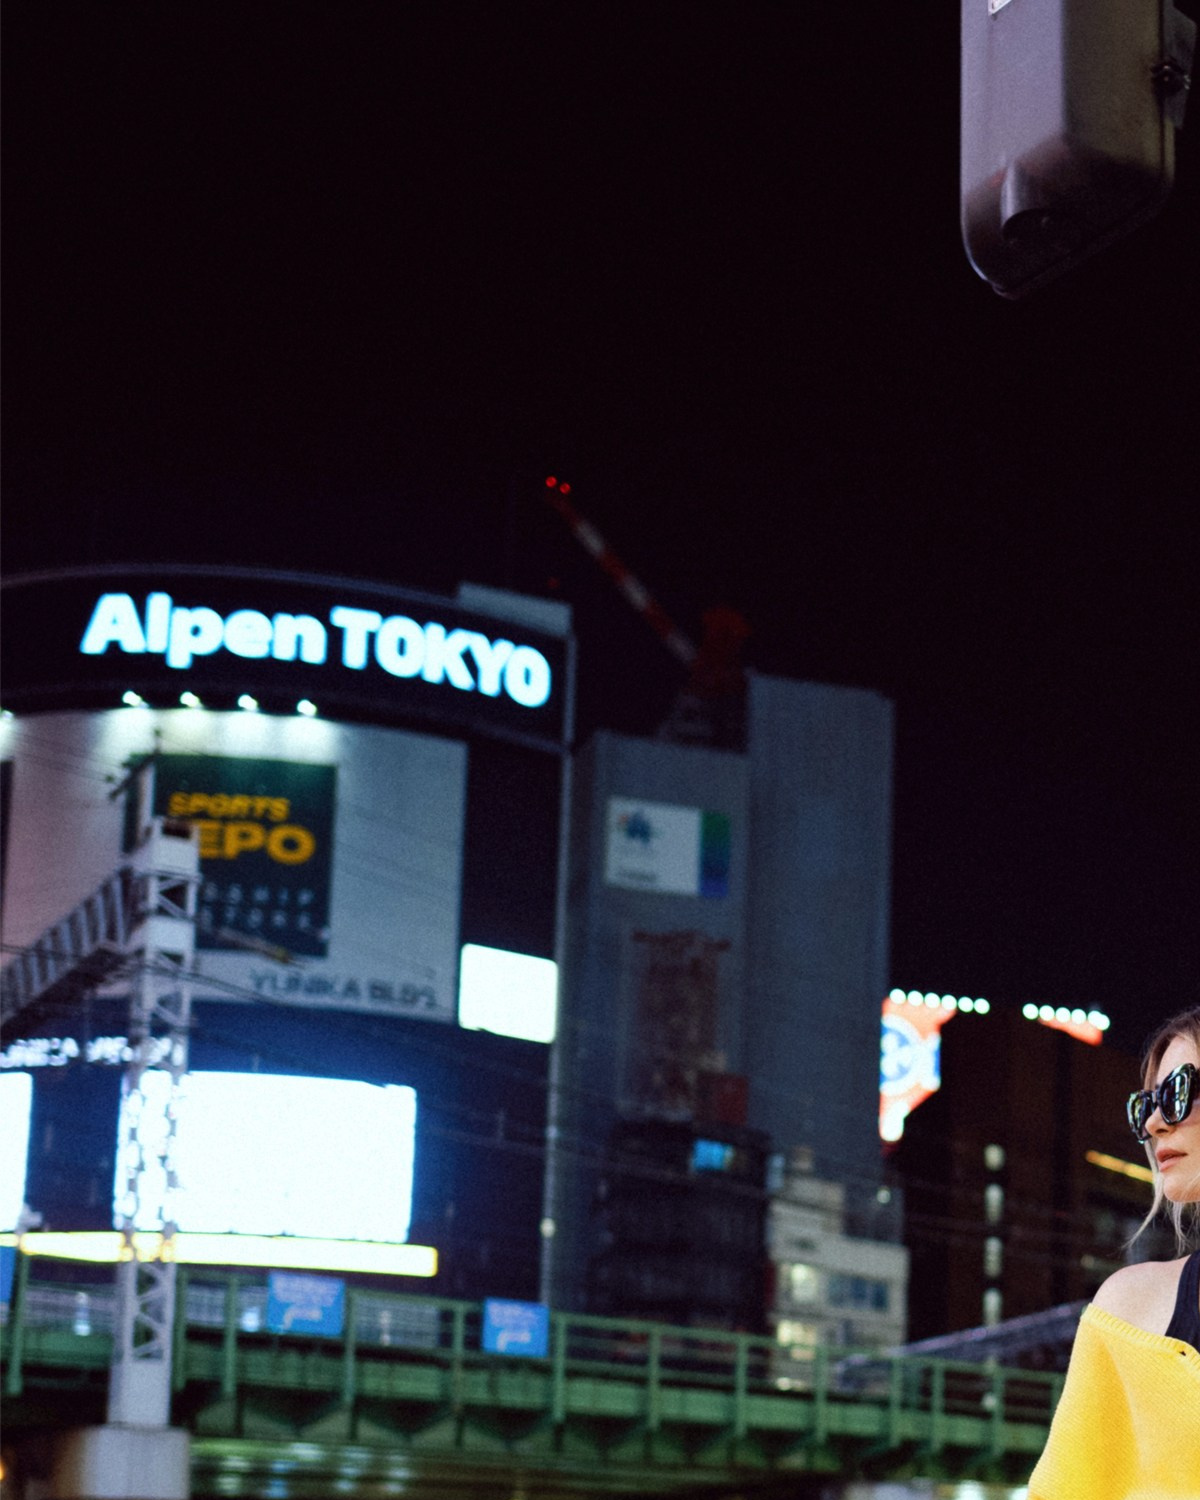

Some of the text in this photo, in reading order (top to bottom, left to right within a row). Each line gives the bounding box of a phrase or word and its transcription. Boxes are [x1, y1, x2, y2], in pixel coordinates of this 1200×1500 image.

[80, 592, 552, 707] Alpen TOKYO
[168, 792, 290, 822] SPORTS
[191, 818, 316, 865] EPO
